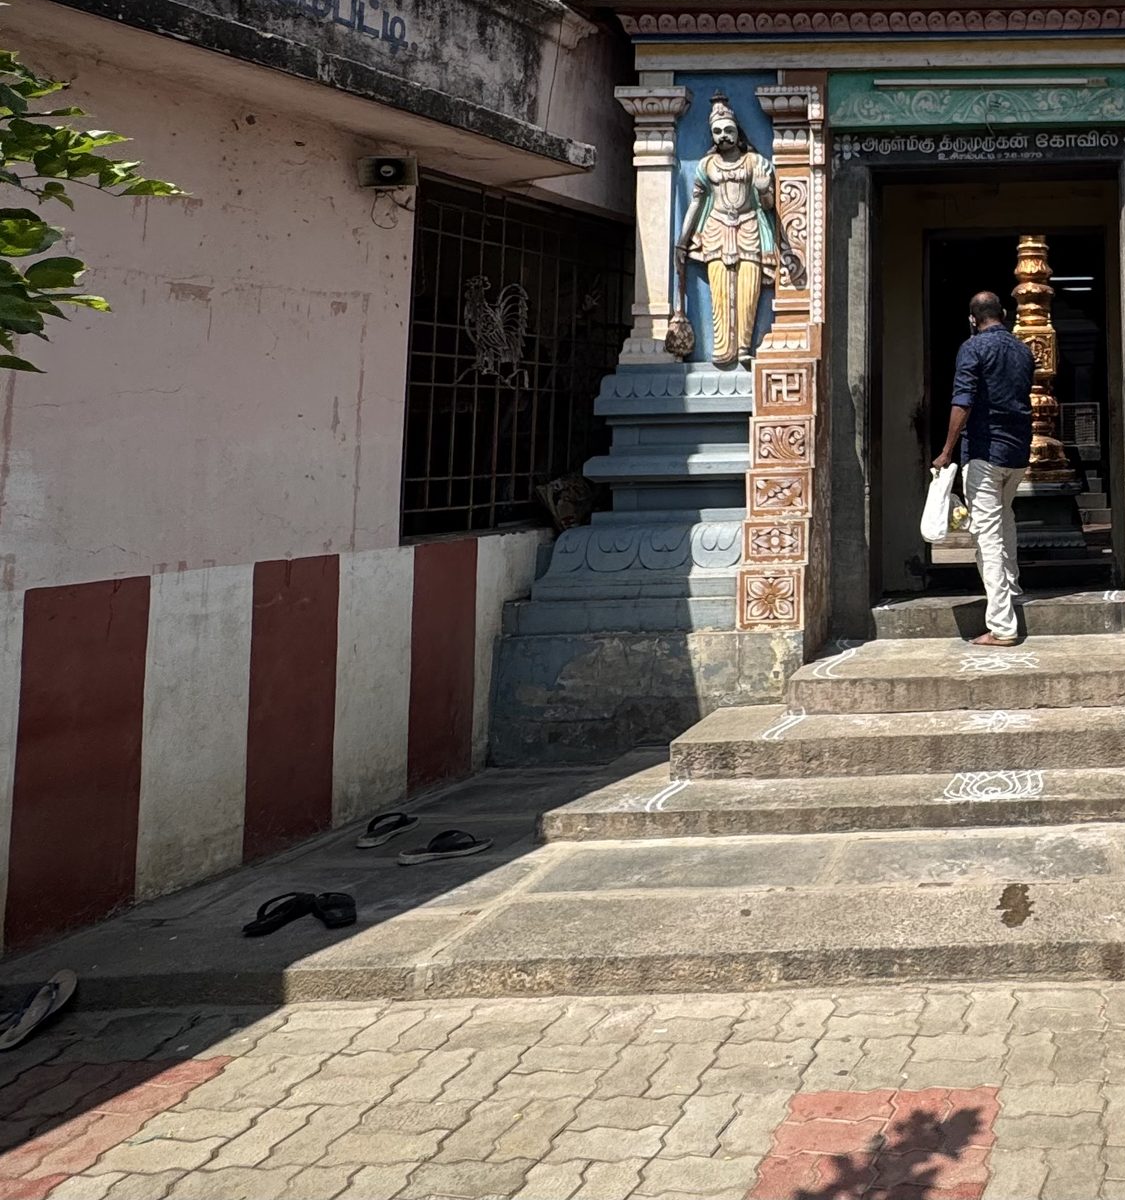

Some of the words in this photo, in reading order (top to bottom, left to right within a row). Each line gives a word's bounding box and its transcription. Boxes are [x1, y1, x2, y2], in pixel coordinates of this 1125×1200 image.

[861, 135, 935, 155] அருள்மிகு
[937, 133, 1029, 152] திருமுருகன்
[1035, 130, 1119, 148] கோவில்
